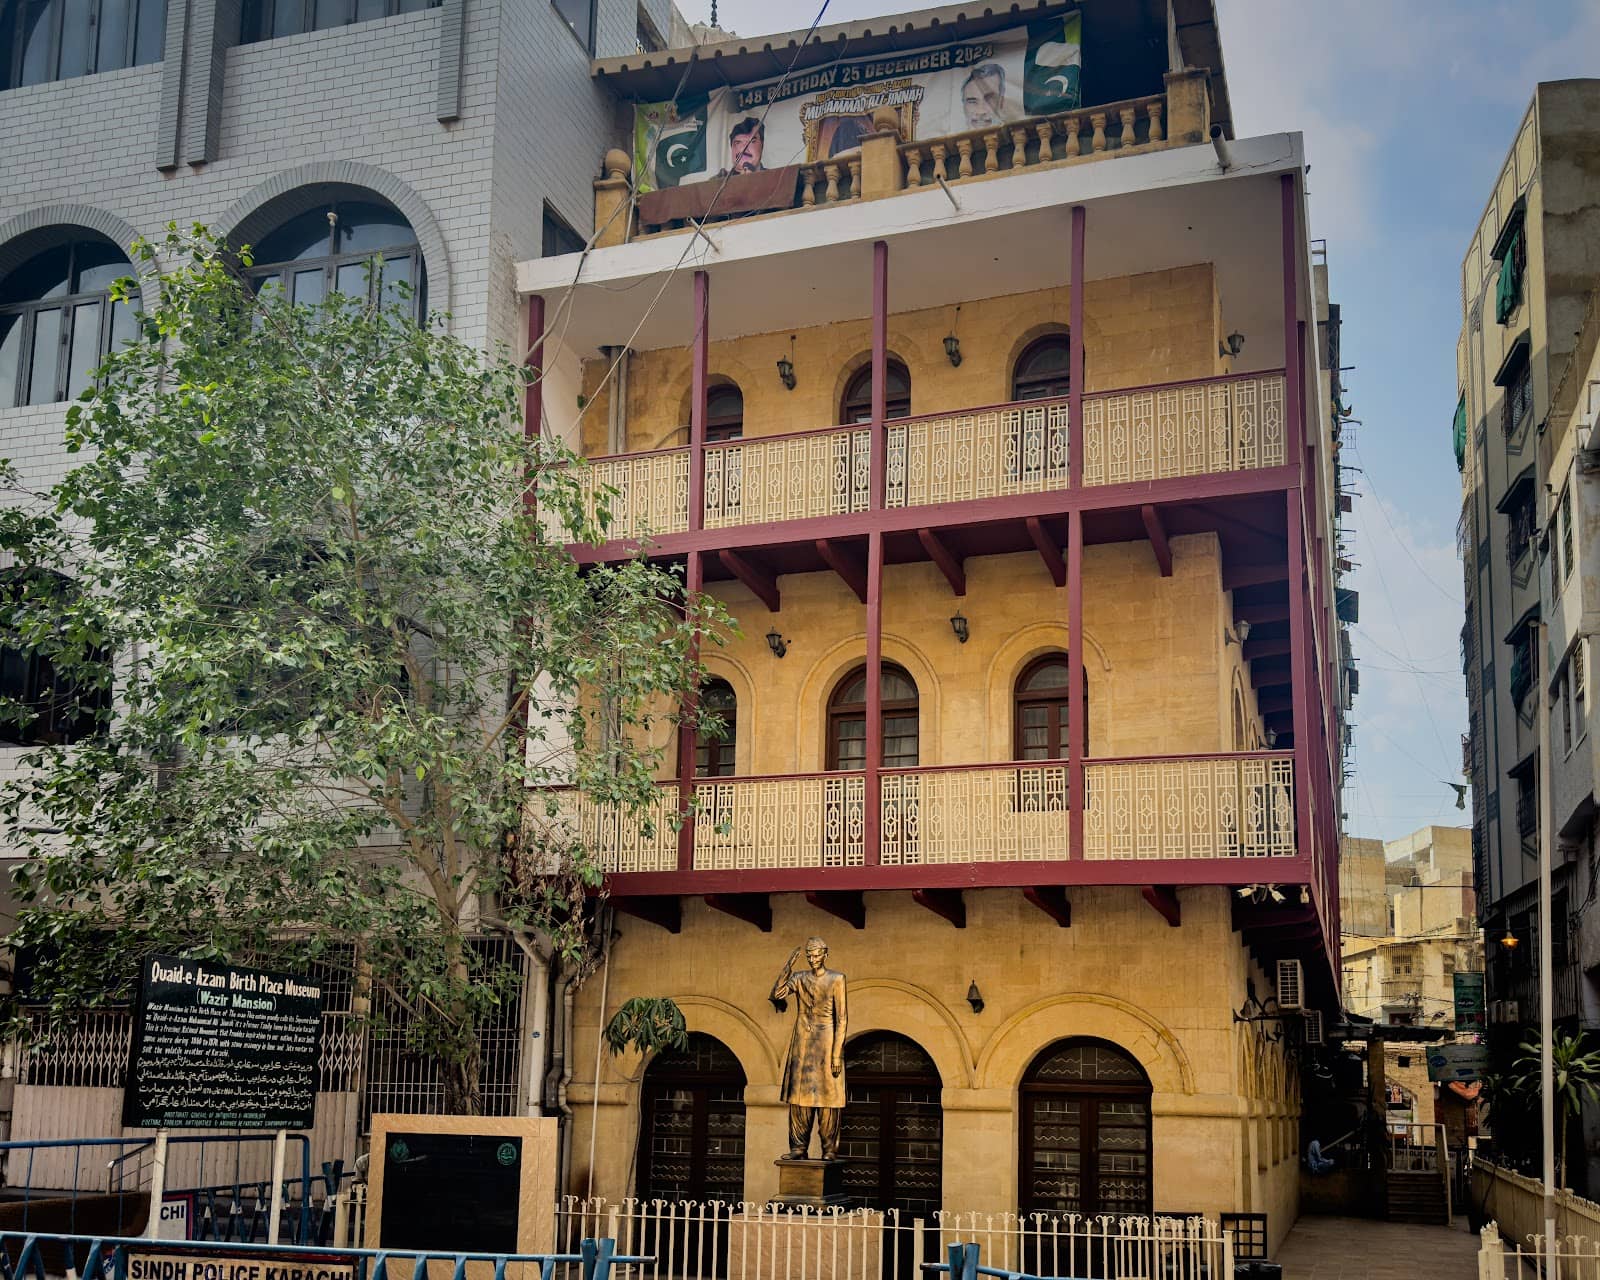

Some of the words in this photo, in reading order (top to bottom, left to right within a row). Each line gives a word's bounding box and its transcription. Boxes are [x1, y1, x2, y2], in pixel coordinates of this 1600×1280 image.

[740, 90, 762, 106] 148
[767, 68, 838, 100] BIRTHDAY
[842, 66, 860, 83] 25
[864, 50, 951, 78] DECEMBER
[954, 44, 993, 64] 2024
[804, 97, 866, 120] MUHAMMAD
[886, 87, 925, 106] JINNAH
[229, 971, 257, 992] Birth
[259, 974, 284, 995] Place
[284, 978, 320, 999] Museum
[196, 988, 229, 1006] (Wazir
[231, 993, 277, 1013] Mansion)
[160, 1204, 185, 1221] CHI
[131, 1259, 187, 1280] SINDH
[193, 1263, 260, 1280] POLICE
